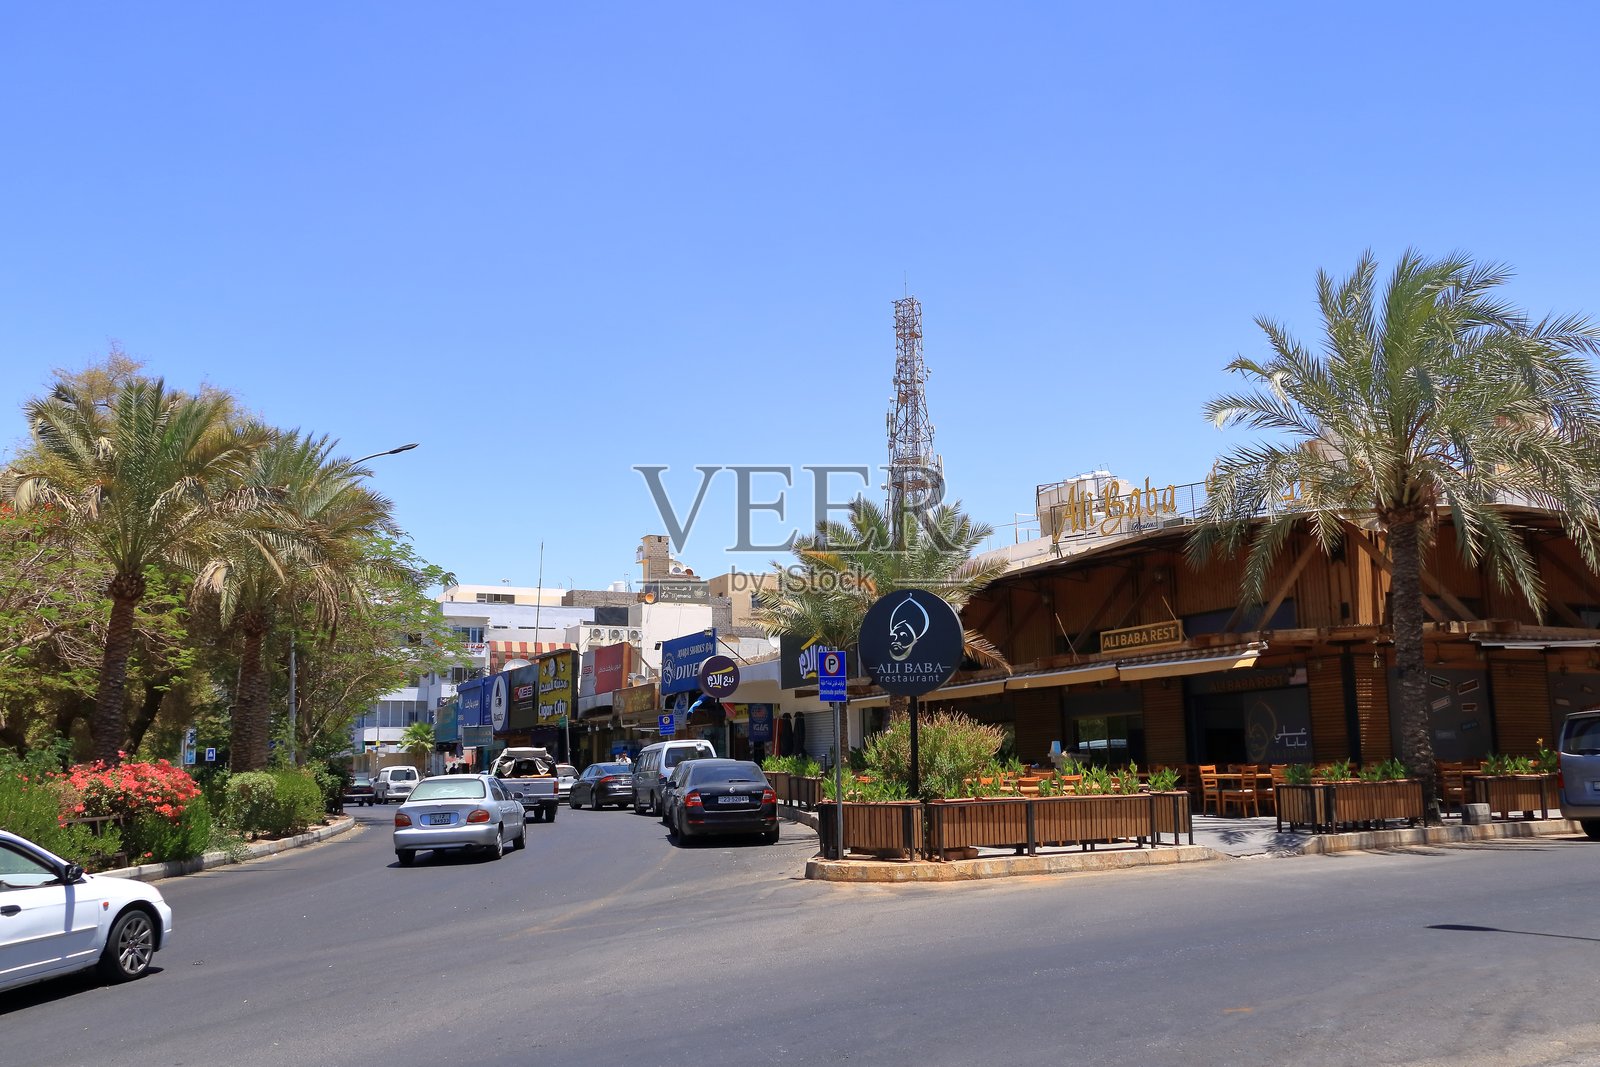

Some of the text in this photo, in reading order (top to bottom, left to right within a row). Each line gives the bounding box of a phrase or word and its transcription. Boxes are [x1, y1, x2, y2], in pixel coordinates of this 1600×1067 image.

[1051, 485, 1096, 544] Ali
[1099, 476, 1177, 536] Baba
[1104, 626, 1176, 649] ALI BABA REST
[828, 659, 836, 670] P
[877, 662, 943, 674] ALI BABA
[880, 674, 940, 683] restaurant
[554, 699, 567, 716] City
[1274, 725, 1307, 743] علي
[1286, 736, 1307, 749] بابا
